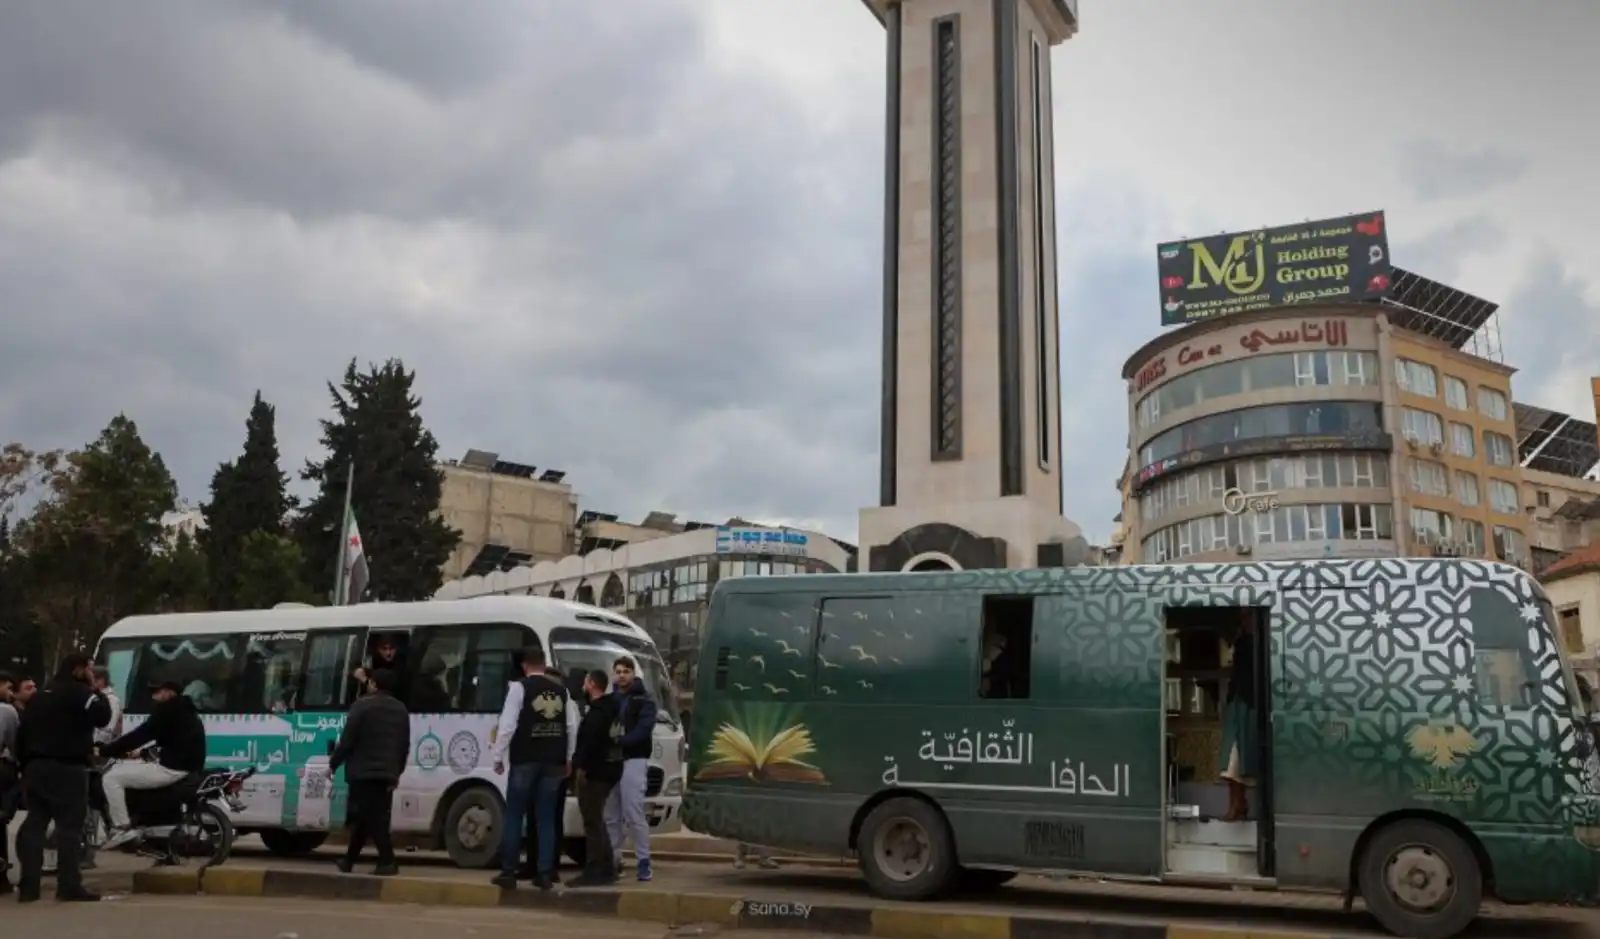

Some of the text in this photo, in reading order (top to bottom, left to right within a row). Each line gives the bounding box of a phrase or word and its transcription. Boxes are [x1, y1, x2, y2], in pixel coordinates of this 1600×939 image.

[1277, 245, 1349, 264] Holding
[1276, 263, 1349, 284] Group
[881, 756, 1130, 797] الحافلة
